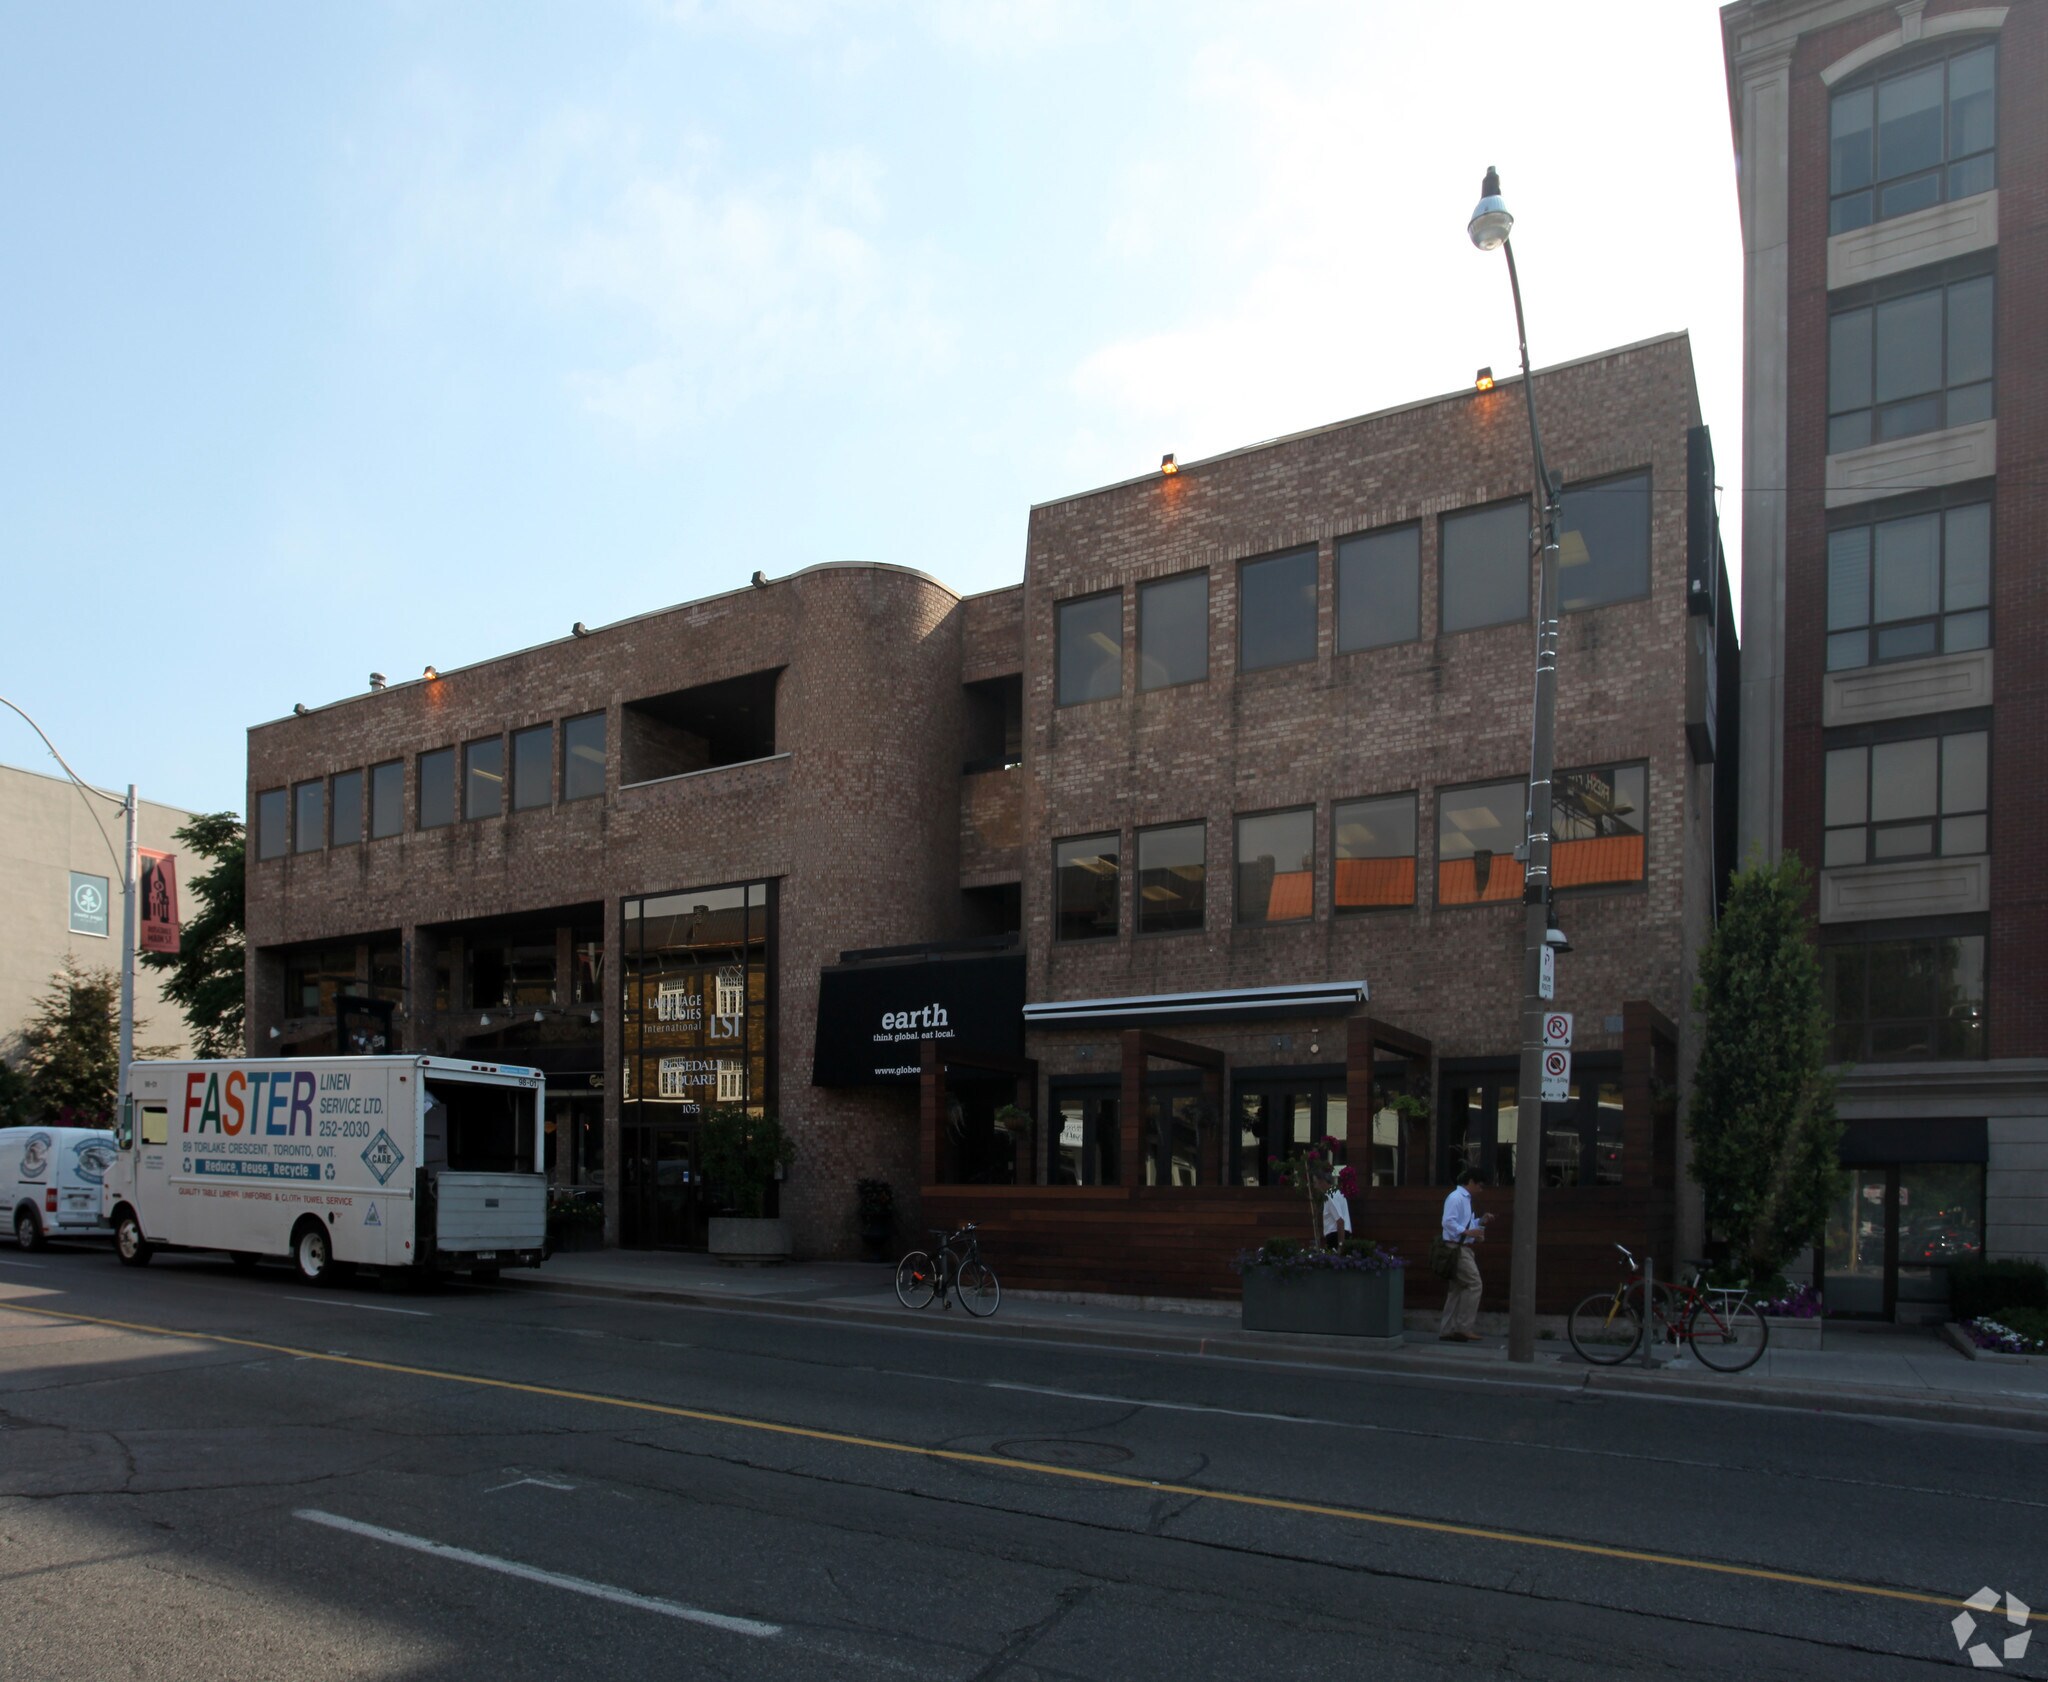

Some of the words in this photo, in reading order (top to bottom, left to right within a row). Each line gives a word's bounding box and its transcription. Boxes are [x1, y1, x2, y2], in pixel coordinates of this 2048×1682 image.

[881, 1002, 949, 1031] earth
[643, 1020, 702, 1034] International
[873, 1033, 893, 1042] think
[894, 1031, 920, 1043] global.
[921, 1030, 936, 1040] eat
[935, 1028, 956, 1039] local.
[320, 1073, 352, 1091] LINEN
[518, 1077, 537, 1088] 98-01
[183, 1070, 317, 1137] FASTER
[319, 1097, 361, 1115] SERVICE
[362, 1097, 384, 1115] LTD.
[682, 1103, 701, 1115] 1055
[319, 1120, 371, 1138] 252-2030
[193, 1141, 226, 1154] TORLAKE
[228, 1143, 271, 1156] CRESCENT,
[273, 1144, 314, 1158] TORONTO,
[316, 1146, 337, 1158] ONT.
[377, 1144, 388, 1154] WE
[371, 1153, 392, 1165] CARE
[204, 1160, 239, 1175] Reduce,
[241, 1161, 271, 1177] Reuse,
[273, 1163, 312, 1178] Recycle.
[178, 1187, 200, 1196] QUALITY
[202, 1188, 218, 1198] TABLE
[303, 1195, 324, 1205] TOWEL
[326, 1196, 353, 1207] SERVICE
